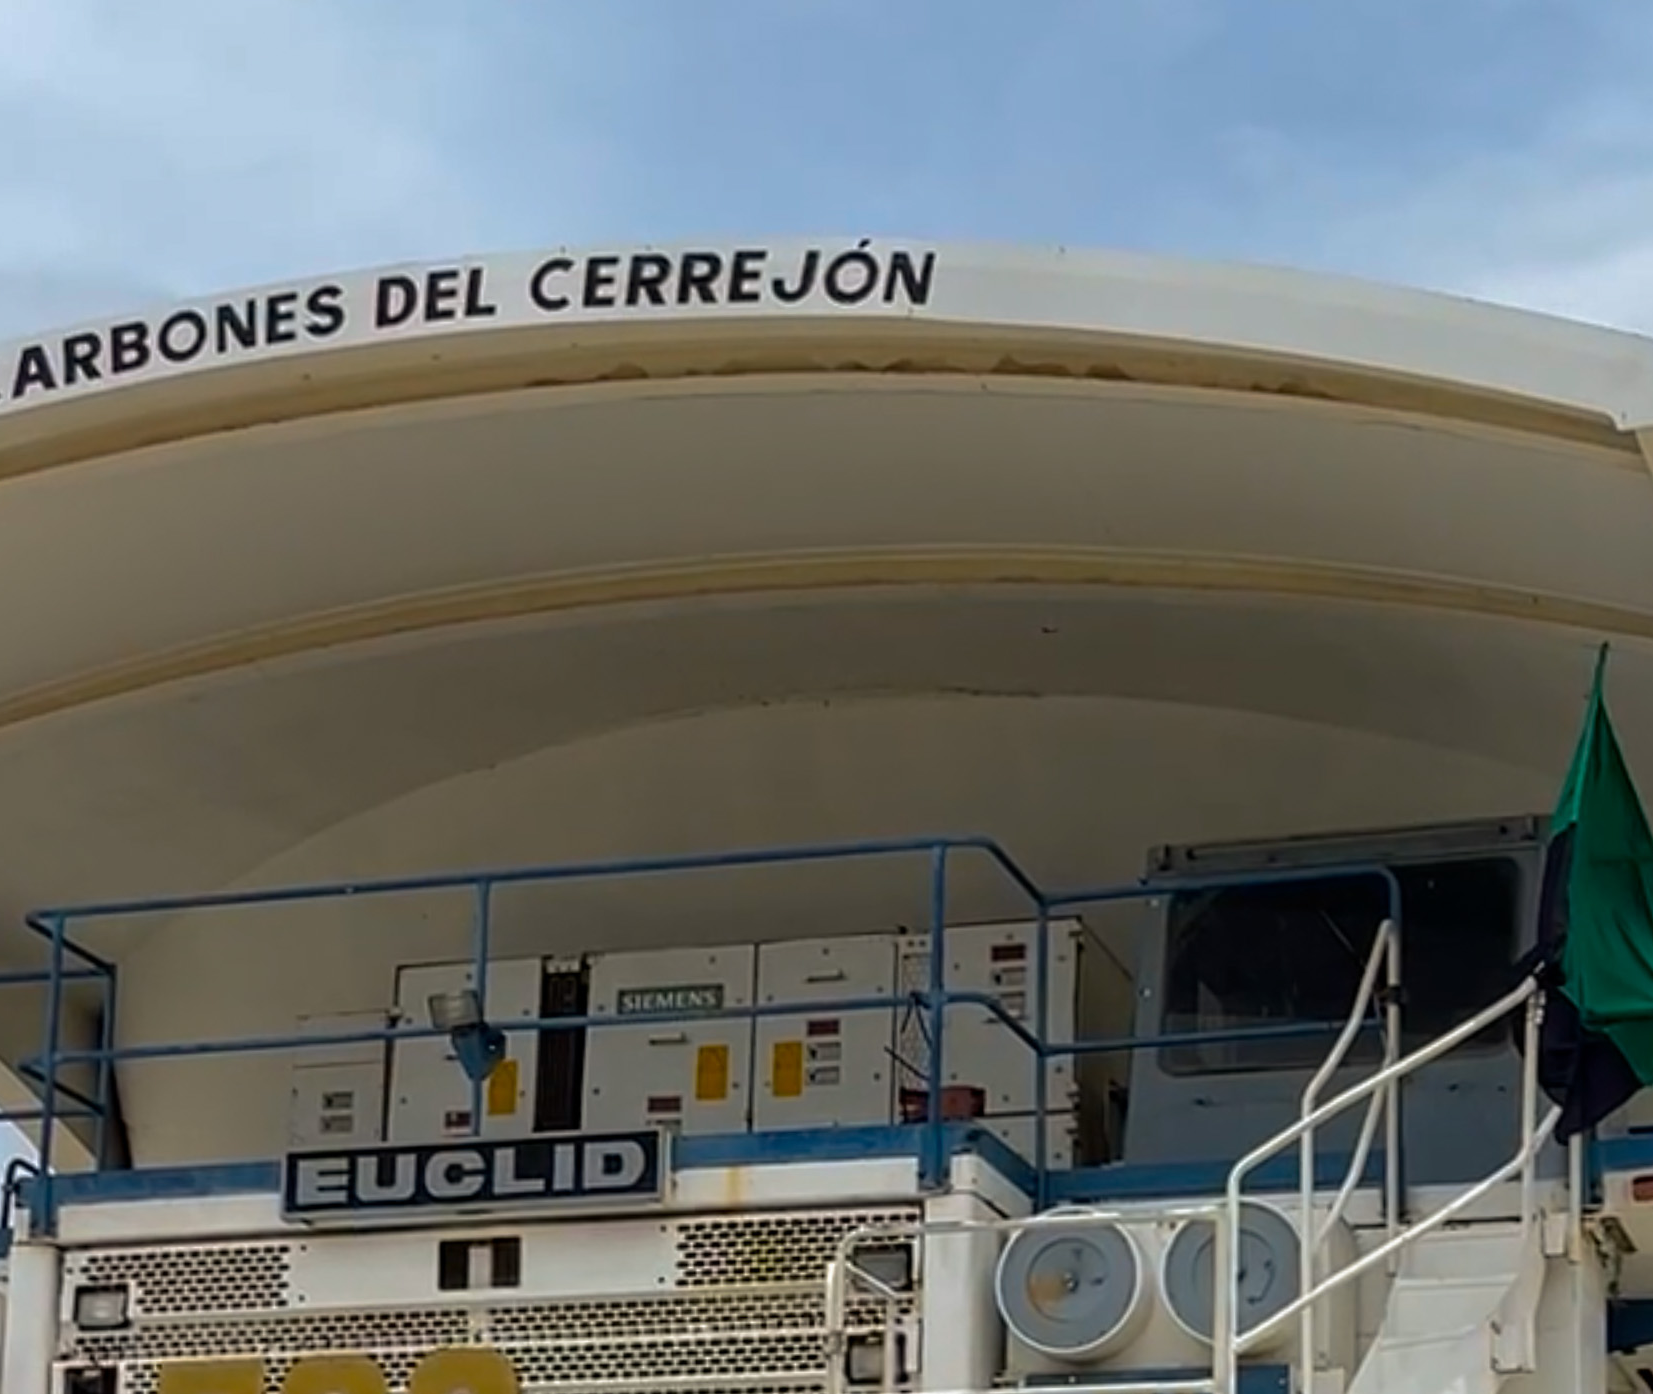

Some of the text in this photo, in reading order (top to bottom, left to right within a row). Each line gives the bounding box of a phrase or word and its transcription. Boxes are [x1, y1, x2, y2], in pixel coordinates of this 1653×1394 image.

[374, 267, 496, 328] DEL
[529, 238, 937, 310] CERREJÓN
[621, 989, 718, 1012] SIEMENS
[296, 1139, 647, 1206] EUCLID
